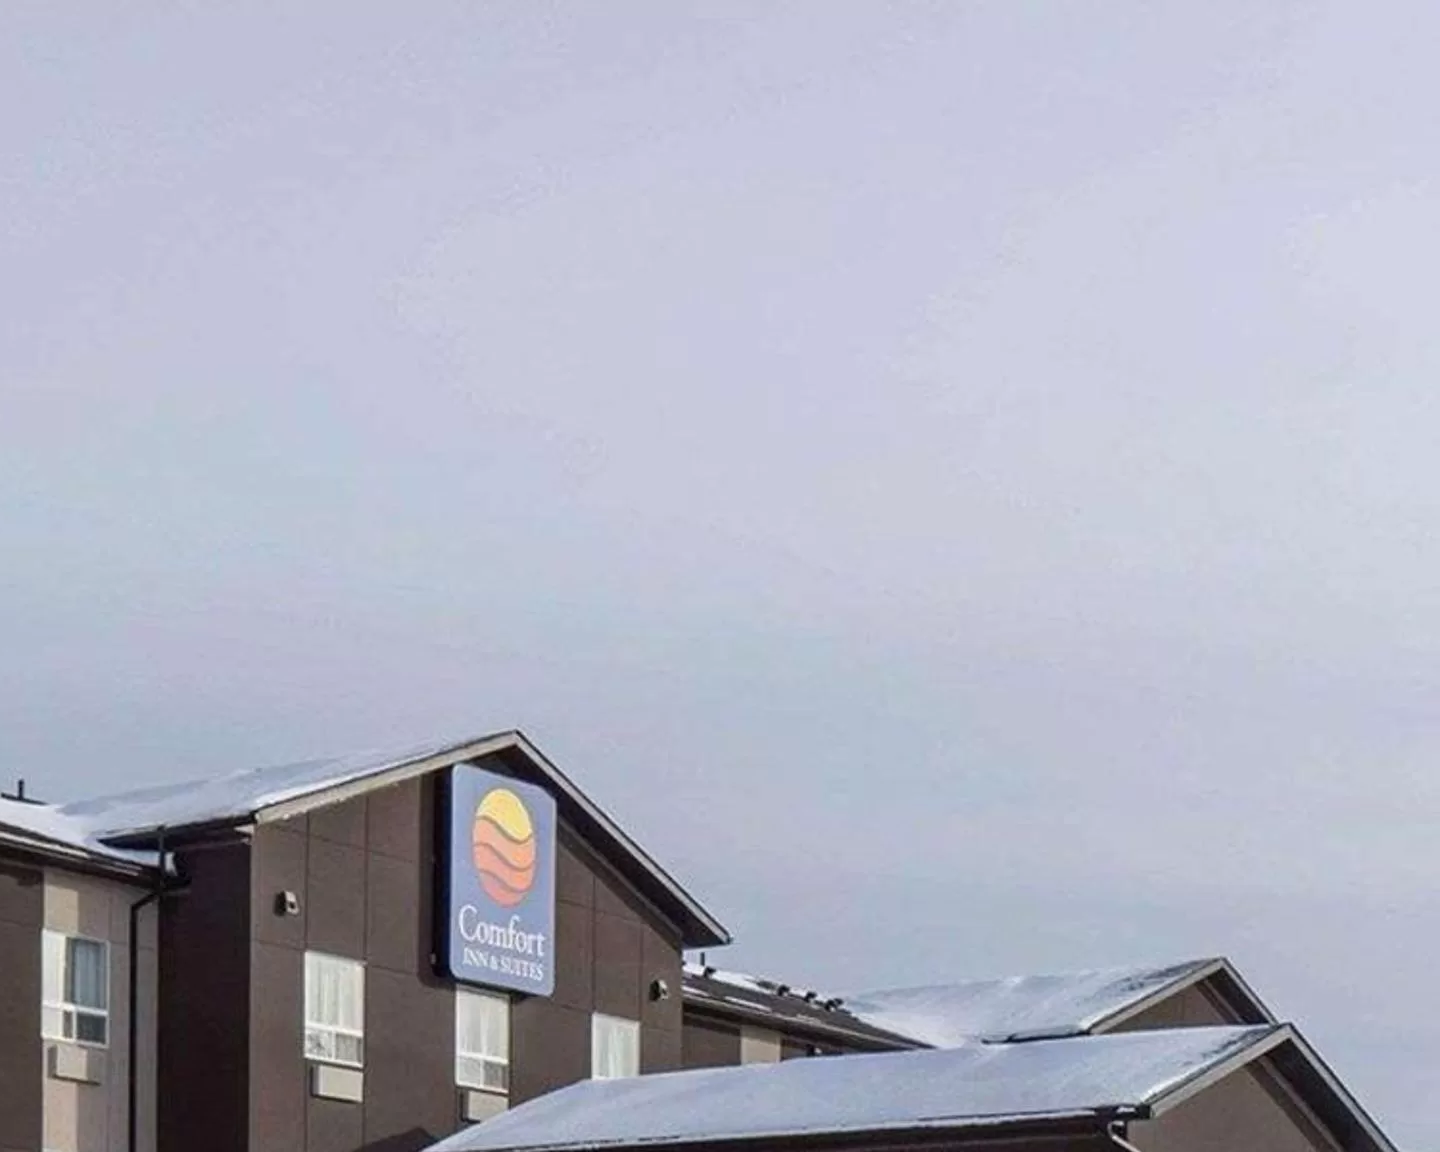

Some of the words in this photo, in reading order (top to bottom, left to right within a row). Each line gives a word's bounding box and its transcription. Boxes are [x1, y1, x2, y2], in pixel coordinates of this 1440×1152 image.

[459, 904, 546, 957] Comfort
[462, 947, 489, 968] INN
[500, 956, 544, 981] SUITES
